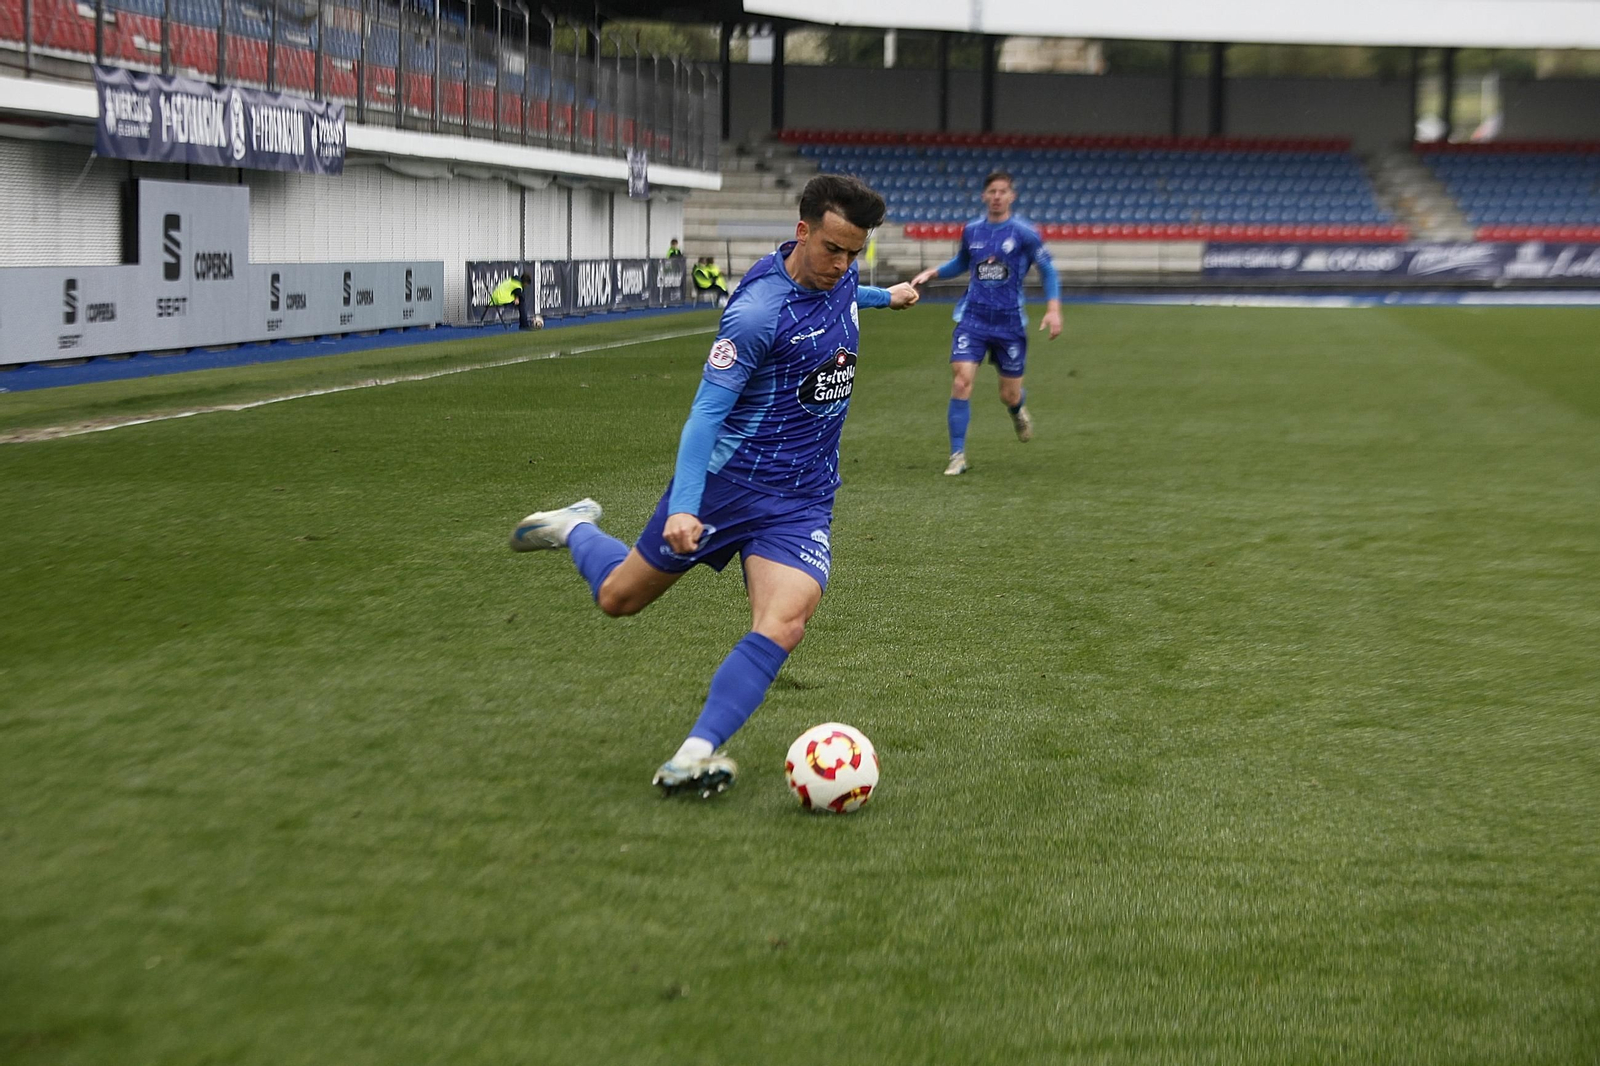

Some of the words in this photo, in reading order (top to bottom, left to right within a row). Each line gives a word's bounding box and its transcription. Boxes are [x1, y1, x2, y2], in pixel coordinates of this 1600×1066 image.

[194, 252, 234, 280] COPERSA
[577, 261, 611, 307] ABANCA
[156, 298, 187, 317] SEAT
